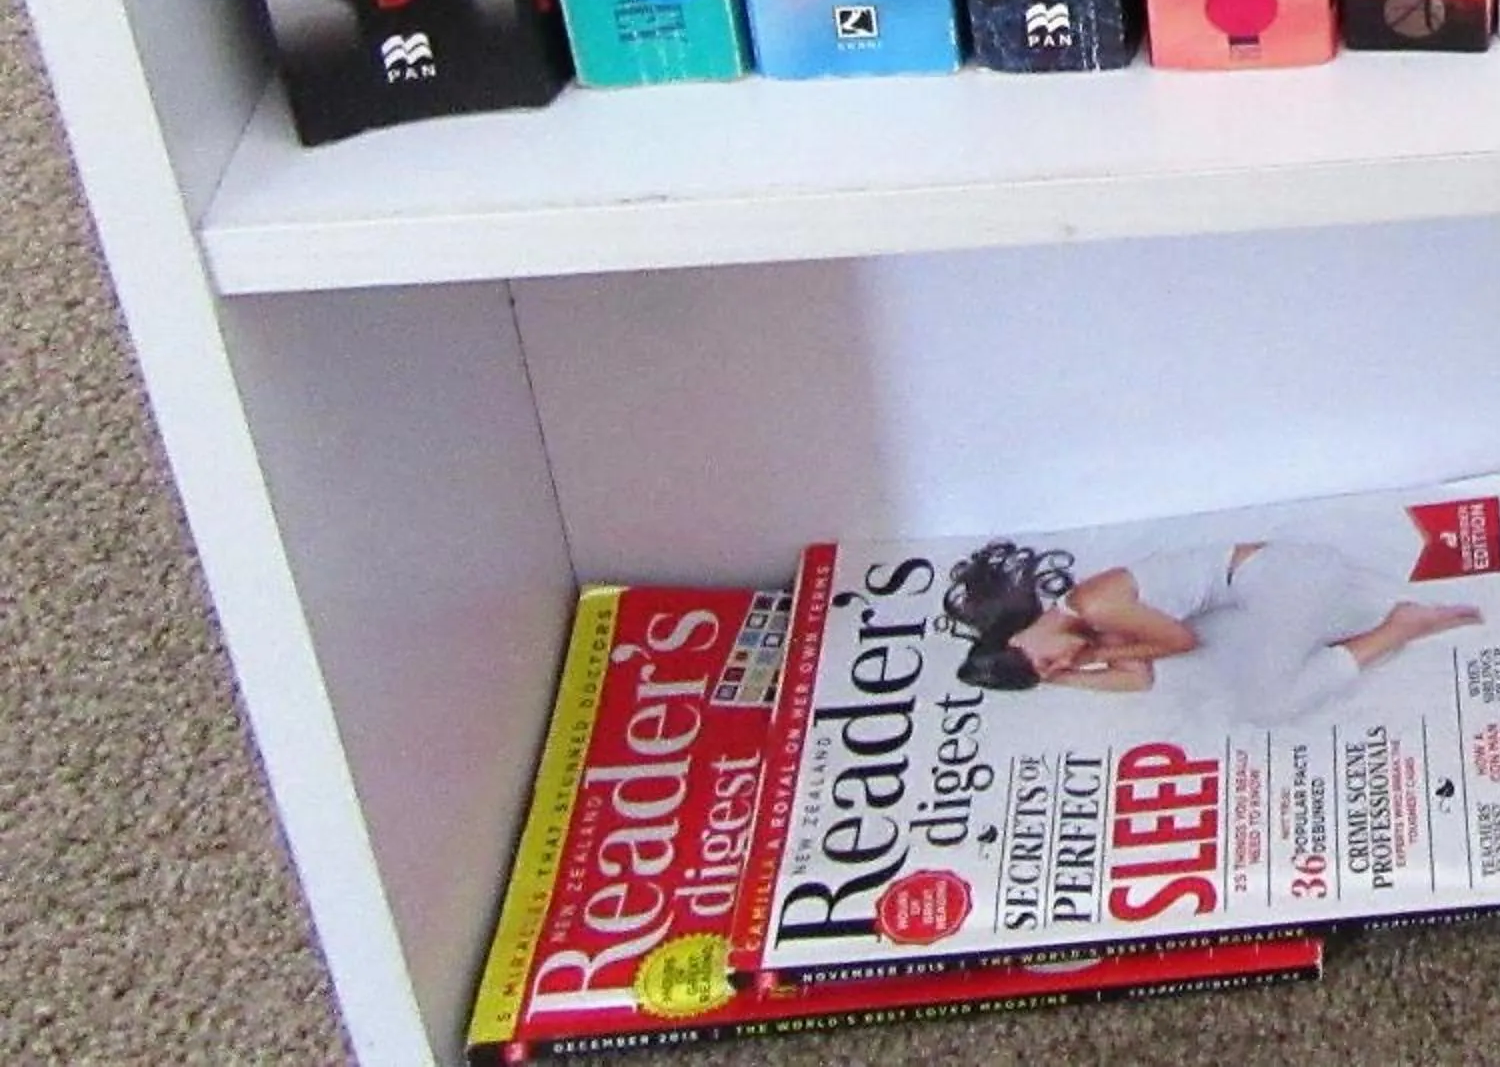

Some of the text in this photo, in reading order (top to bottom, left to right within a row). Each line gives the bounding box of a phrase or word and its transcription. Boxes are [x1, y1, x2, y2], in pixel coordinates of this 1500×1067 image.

[1028, 34, 1072, 47] PAN
[387, 64, 437, 84] PAN
[1471, 503, 1489, 570] EDITION
[809, 563, 831, 623] TERMS
[800, 632, 819, 673] OWN
[792, 682, 810, 718] HER
[537, 827, 561, 876] THAT
[555, 721, 588, 813] STUNNED
[579, 608, 612, 709] DOCTORS
[774, 557, 935, 950] Reader's
[785, 728, 802, 754] ON
[911, 689, 995, 848] digest
[1476, 744, 1488, 776] HOW
[526, 609, 720, 1023] Reader's
[770, 763, 798, 830] ROYAL
[792, 735, 831, 877] NEW ZEALAND
[1249, 810, 1260, 826] TO
[1292, 745, 1308, 854] POPULAR FACTS
[1311, 777, 1327, 853] DEBUNKED
[1345, 742, 1370, 874] CRIME SCENE
[1366, 725, 1394, 890] PROFESSIONALS
[674, 748, 761, 917] digest
[1004, 753, 1050, 931] SECRETS OF
[1052, 750, 1103, 922] PERFECT
[1108, 741, 1219, 922] SLEEP
[1235, 823, 1247, 870] THINGS
[1249, 830, 1261, 864] NEED
[549, 793, 603, 943] NEW ZEALAND
[1235, 874, 1248, 892] 25
[1290, 855, 1328, 899] 36
[1156, 936, 1210, 951] LOVED
[1218, 928, 1306, 945] MAGAZINE
[802, 961, 946, 983] NOVEMBER 2015
[915, 1003, 971, 1019] LOVED
[978, 994, 1069, 1014] MAGAZINE
[553, 1034, 649, 1053] DECEMBER
